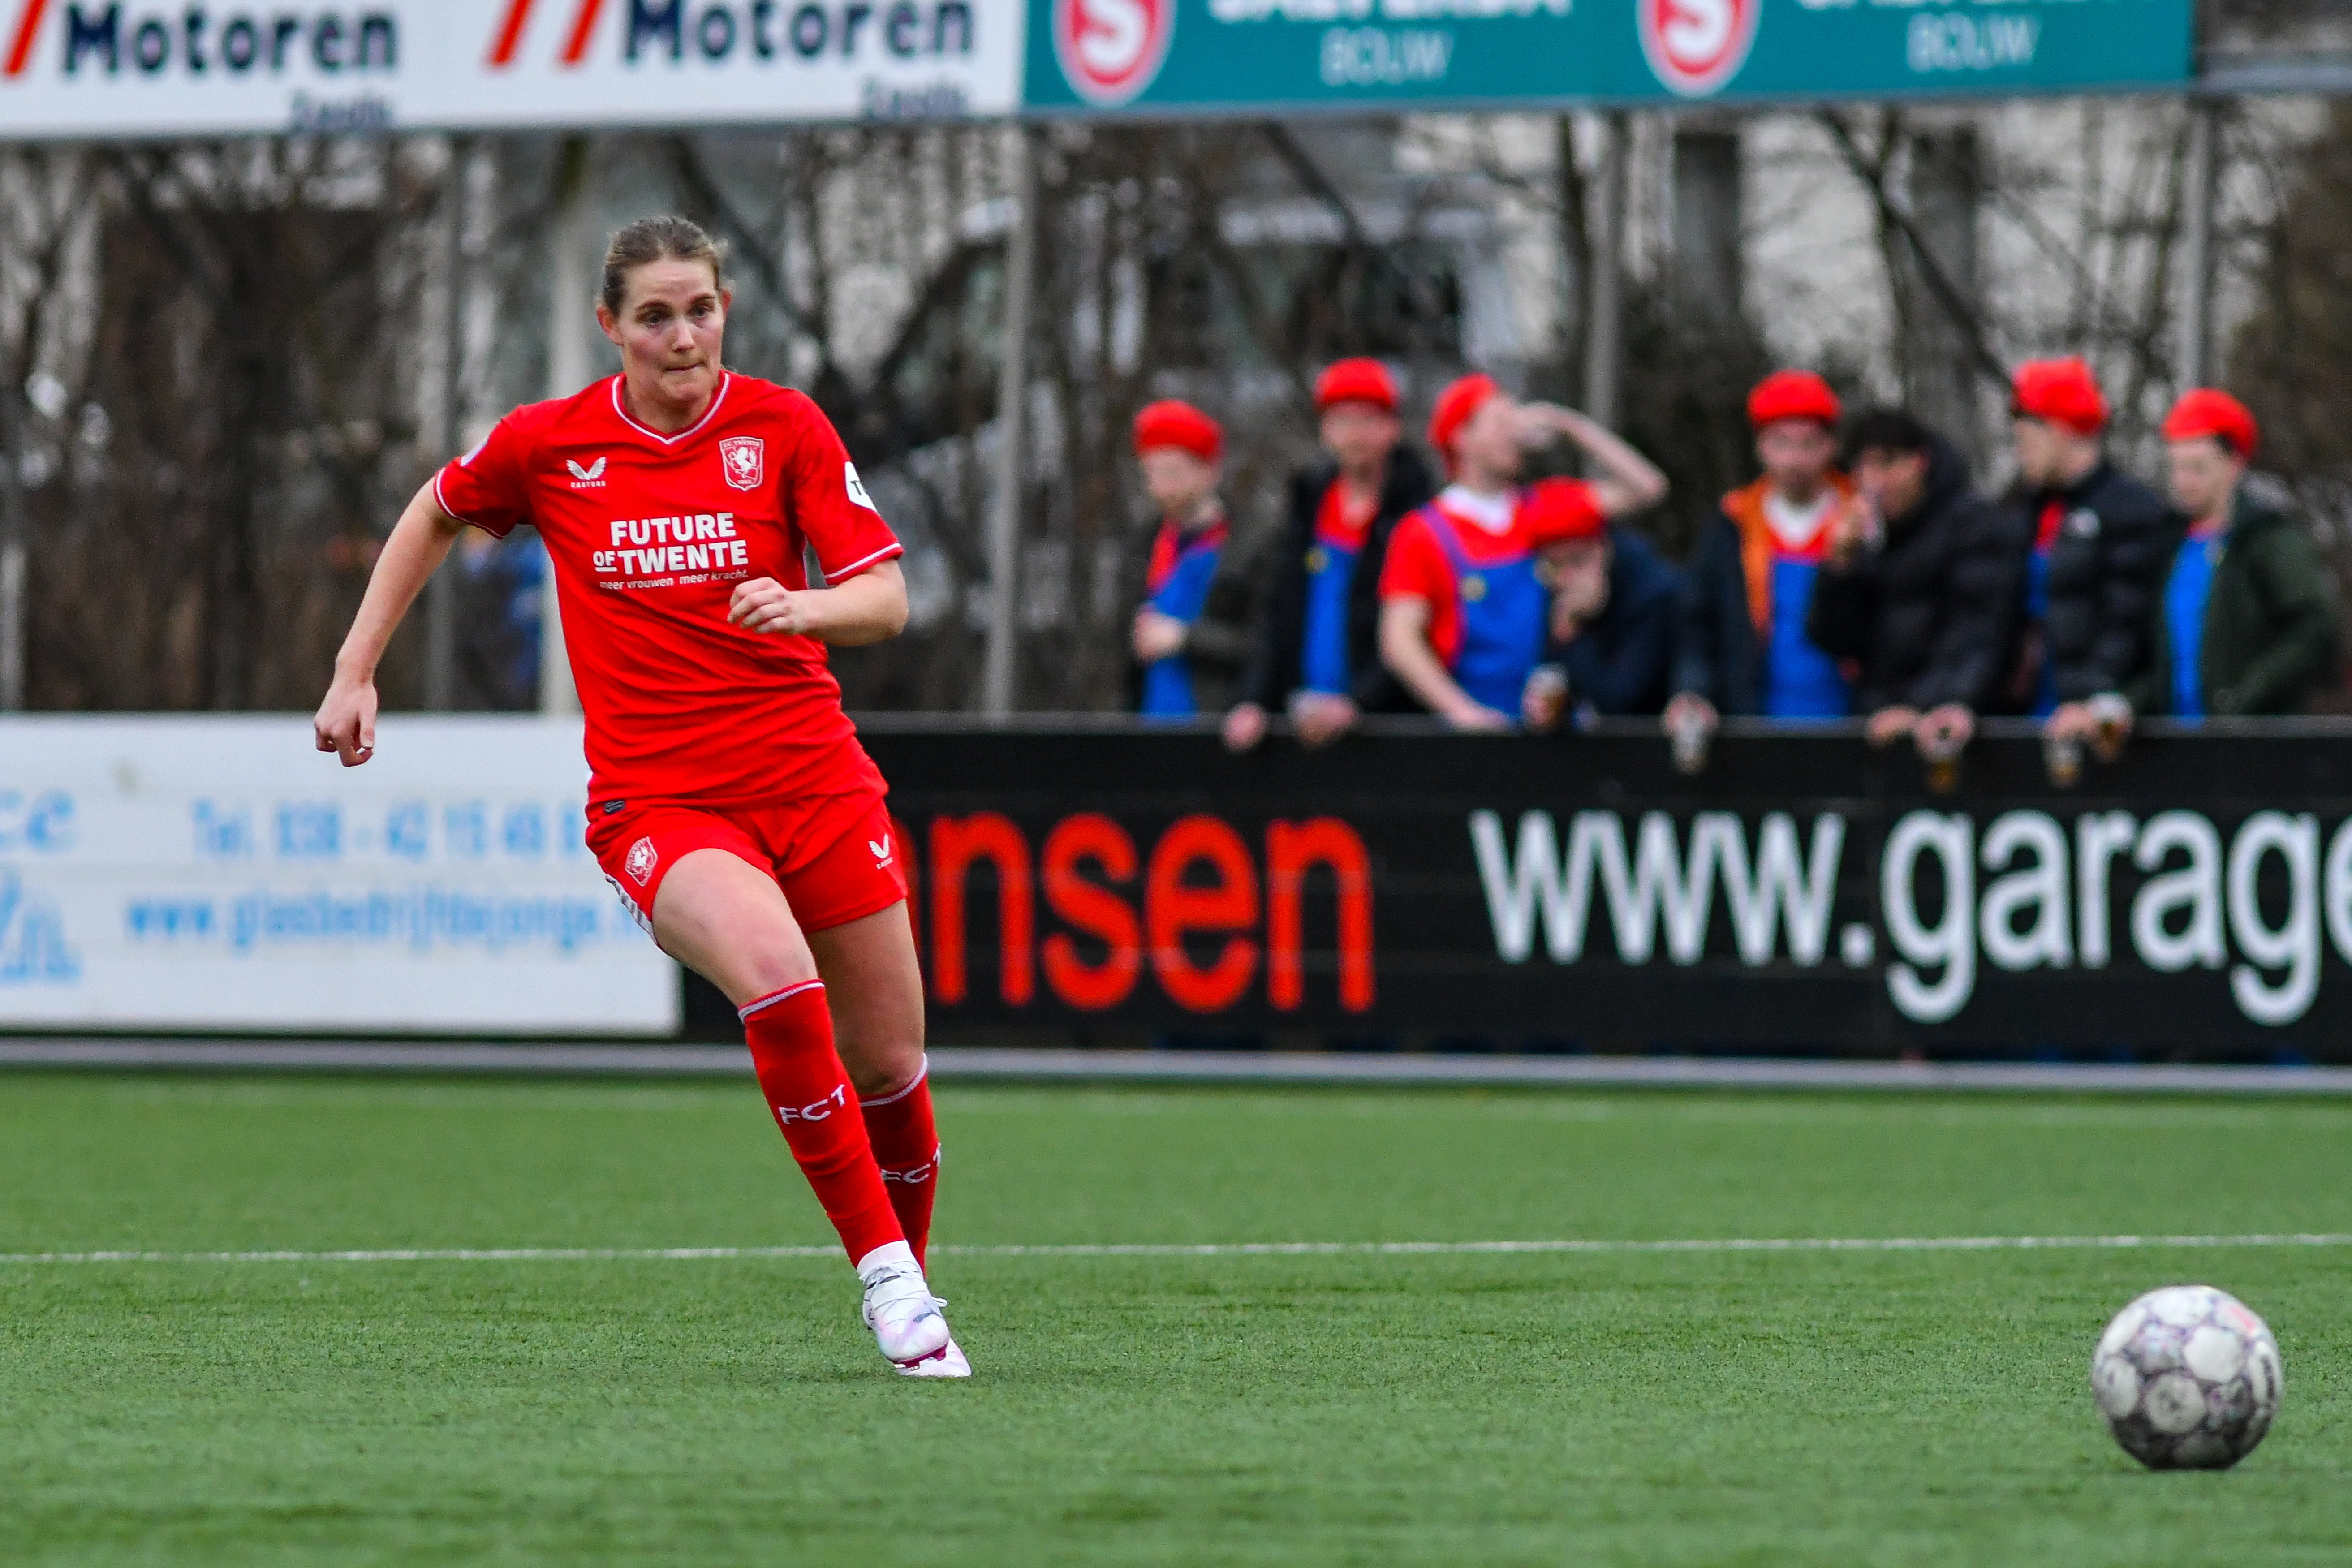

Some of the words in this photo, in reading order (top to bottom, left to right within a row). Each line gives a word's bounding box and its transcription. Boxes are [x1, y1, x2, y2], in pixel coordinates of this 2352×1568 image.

[62, 1, 400, 76] Motoren
[622, 0, 978, 63] Motoren
[610, 513, 737, 546] FUTURE
[593, 551, 616, 566] OF
[617, 539, 749, 575] TWENTE
[627, 577, 673, 589] vrouwen
[679, 573, 709, 585] meer
[892, 810, 1376, 1013] nsen
[778, 1084, 845, 1124] FCT
